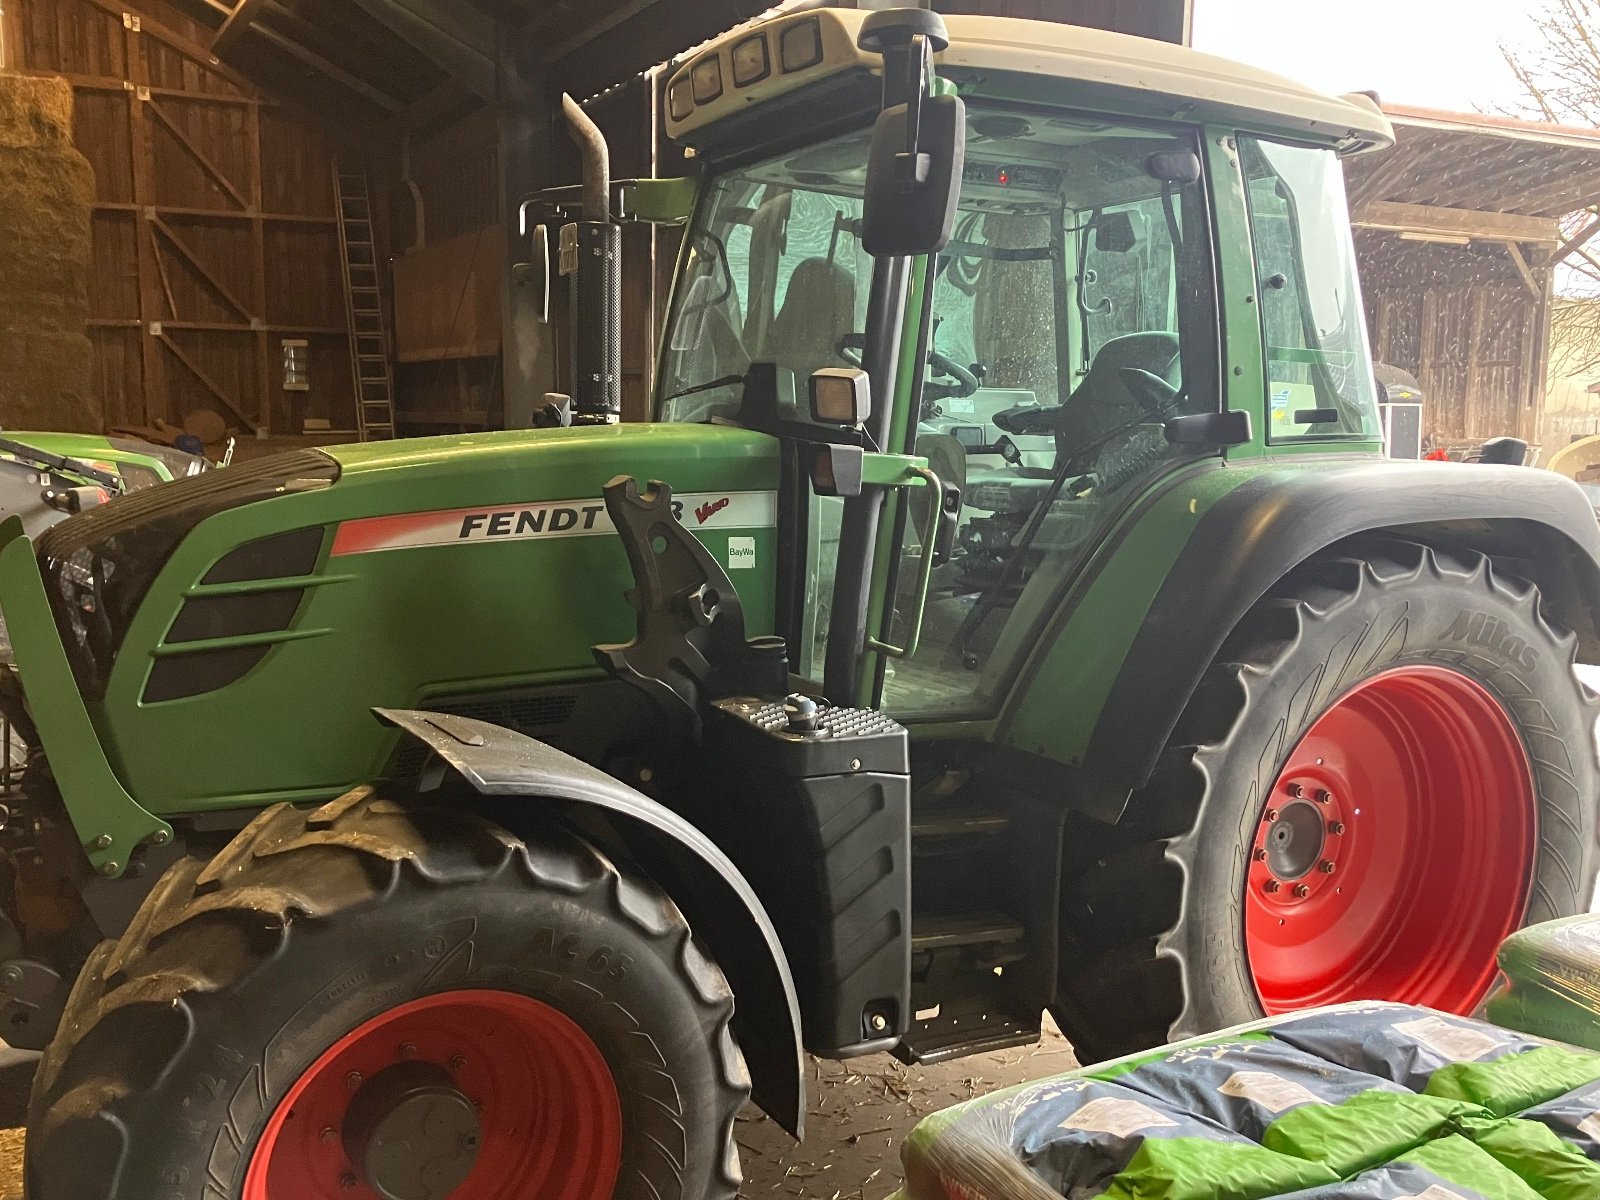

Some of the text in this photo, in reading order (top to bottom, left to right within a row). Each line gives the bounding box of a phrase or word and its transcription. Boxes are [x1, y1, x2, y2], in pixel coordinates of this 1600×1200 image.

[458, 505, 605, 539] FENDT
[729, 547, 754, 557] BayWa
[1438, 608, 1540, 674] Mitas
[587, 944, 635, 981] 65
